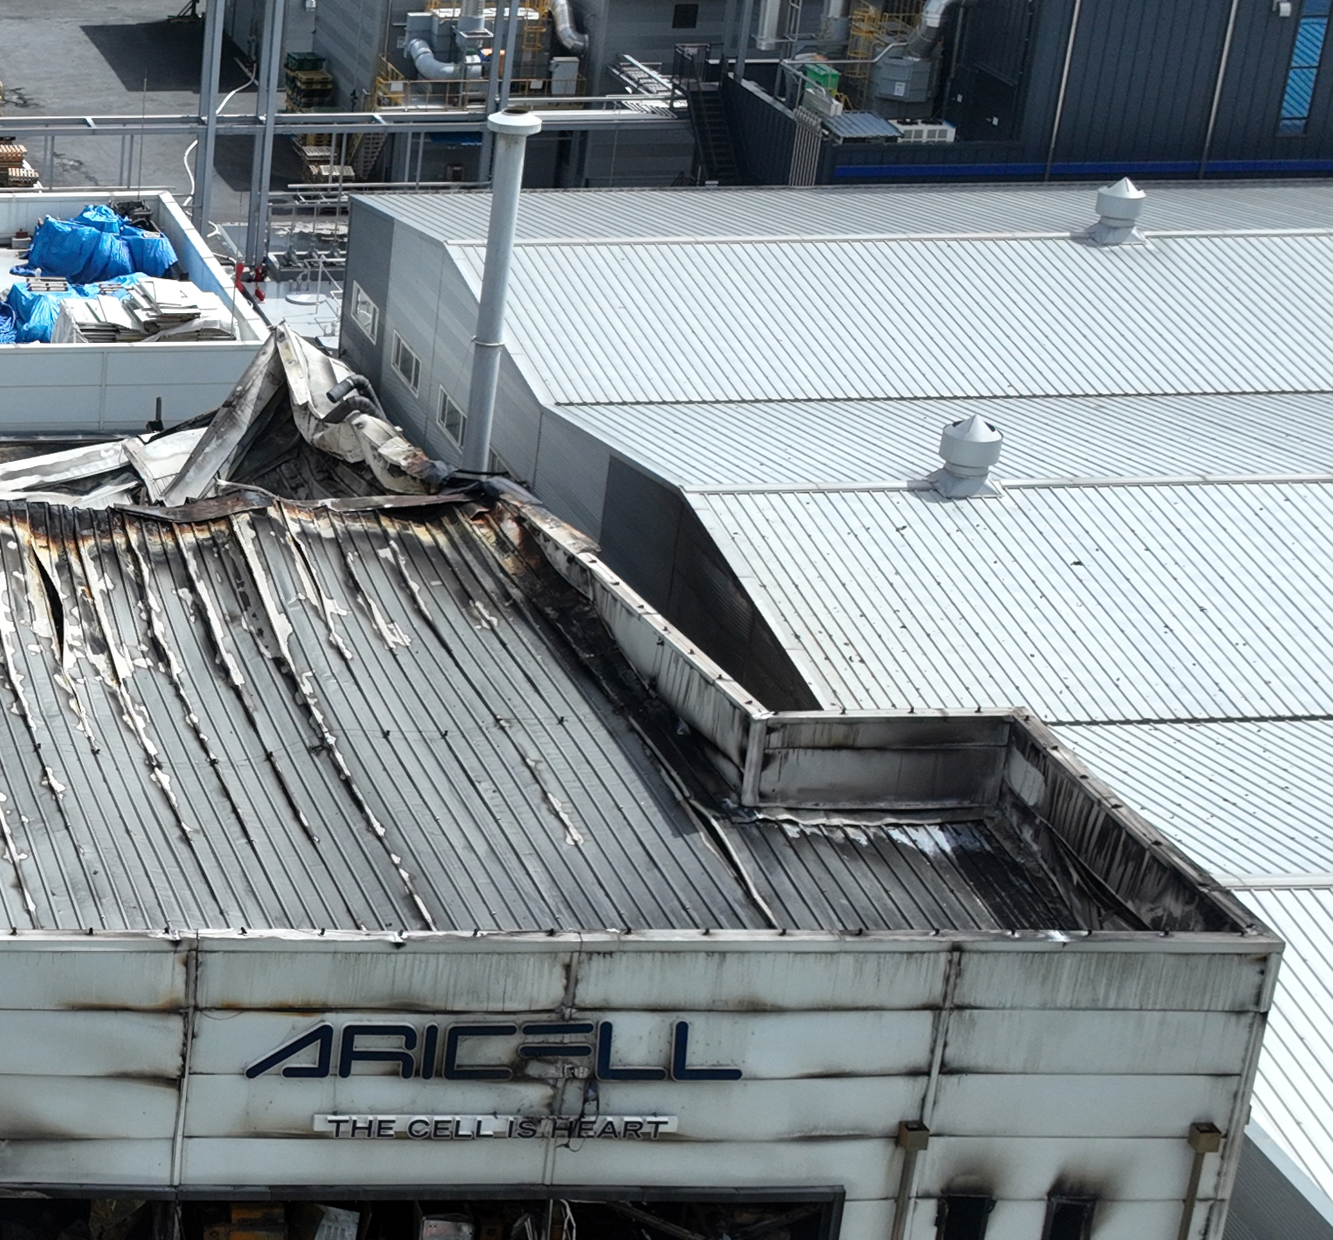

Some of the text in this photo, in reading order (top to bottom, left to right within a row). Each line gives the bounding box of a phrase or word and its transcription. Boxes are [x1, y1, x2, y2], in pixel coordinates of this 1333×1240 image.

[244, 1020, 743, 1081] ARICELL
[328, 1117, 671, 1141] THE CELL IS HEART
